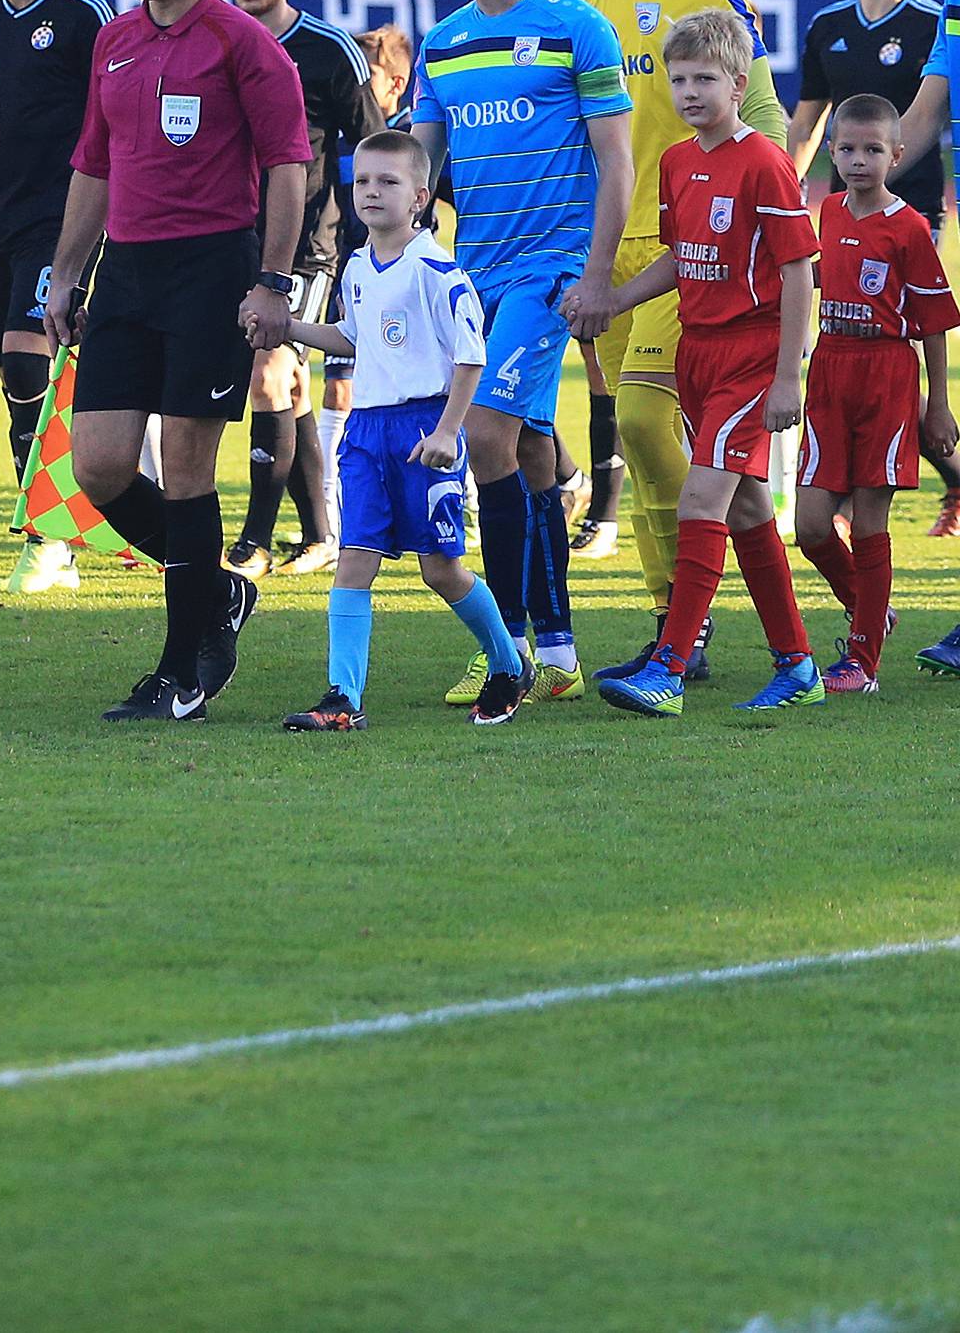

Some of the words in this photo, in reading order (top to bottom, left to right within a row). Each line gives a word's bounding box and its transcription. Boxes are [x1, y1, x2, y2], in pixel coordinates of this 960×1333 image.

[168, 116, 192, 126] FIFA
[35, 265, 52, 304] 6
[642, 347, 663, 355] JAKO
[497, 346, 527, 391] 4
[490, 386, 515, 400] JAKO
